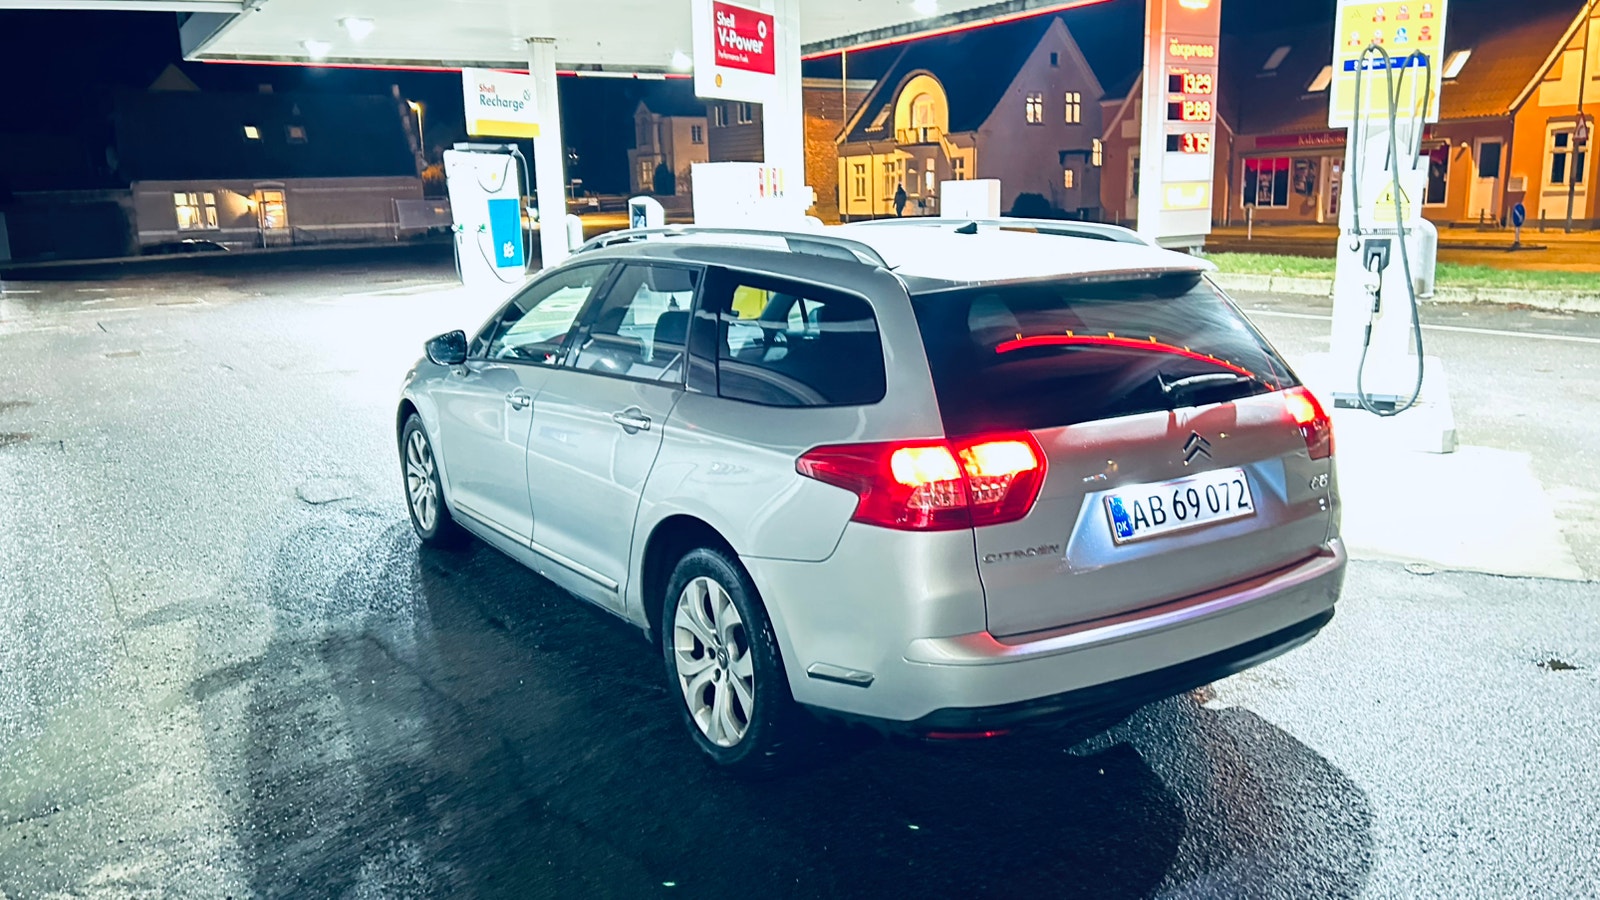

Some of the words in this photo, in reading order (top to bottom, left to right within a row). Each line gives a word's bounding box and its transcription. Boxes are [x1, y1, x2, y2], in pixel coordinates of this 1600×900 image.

[716, 10, 735, 28] Shell
[717, 26, 764, 54] V-Power
[1170, 43, 1214, 60] express
[479, 83, 495, 93] Shell
[479, 94, 524, 112] Recharge
[1134, 495, 1167, 529] AB
[1172, 488, 1200, 521] 69
[1205, 479, 1248, 514] 072
[1116, 521, 1129, 532] DK
